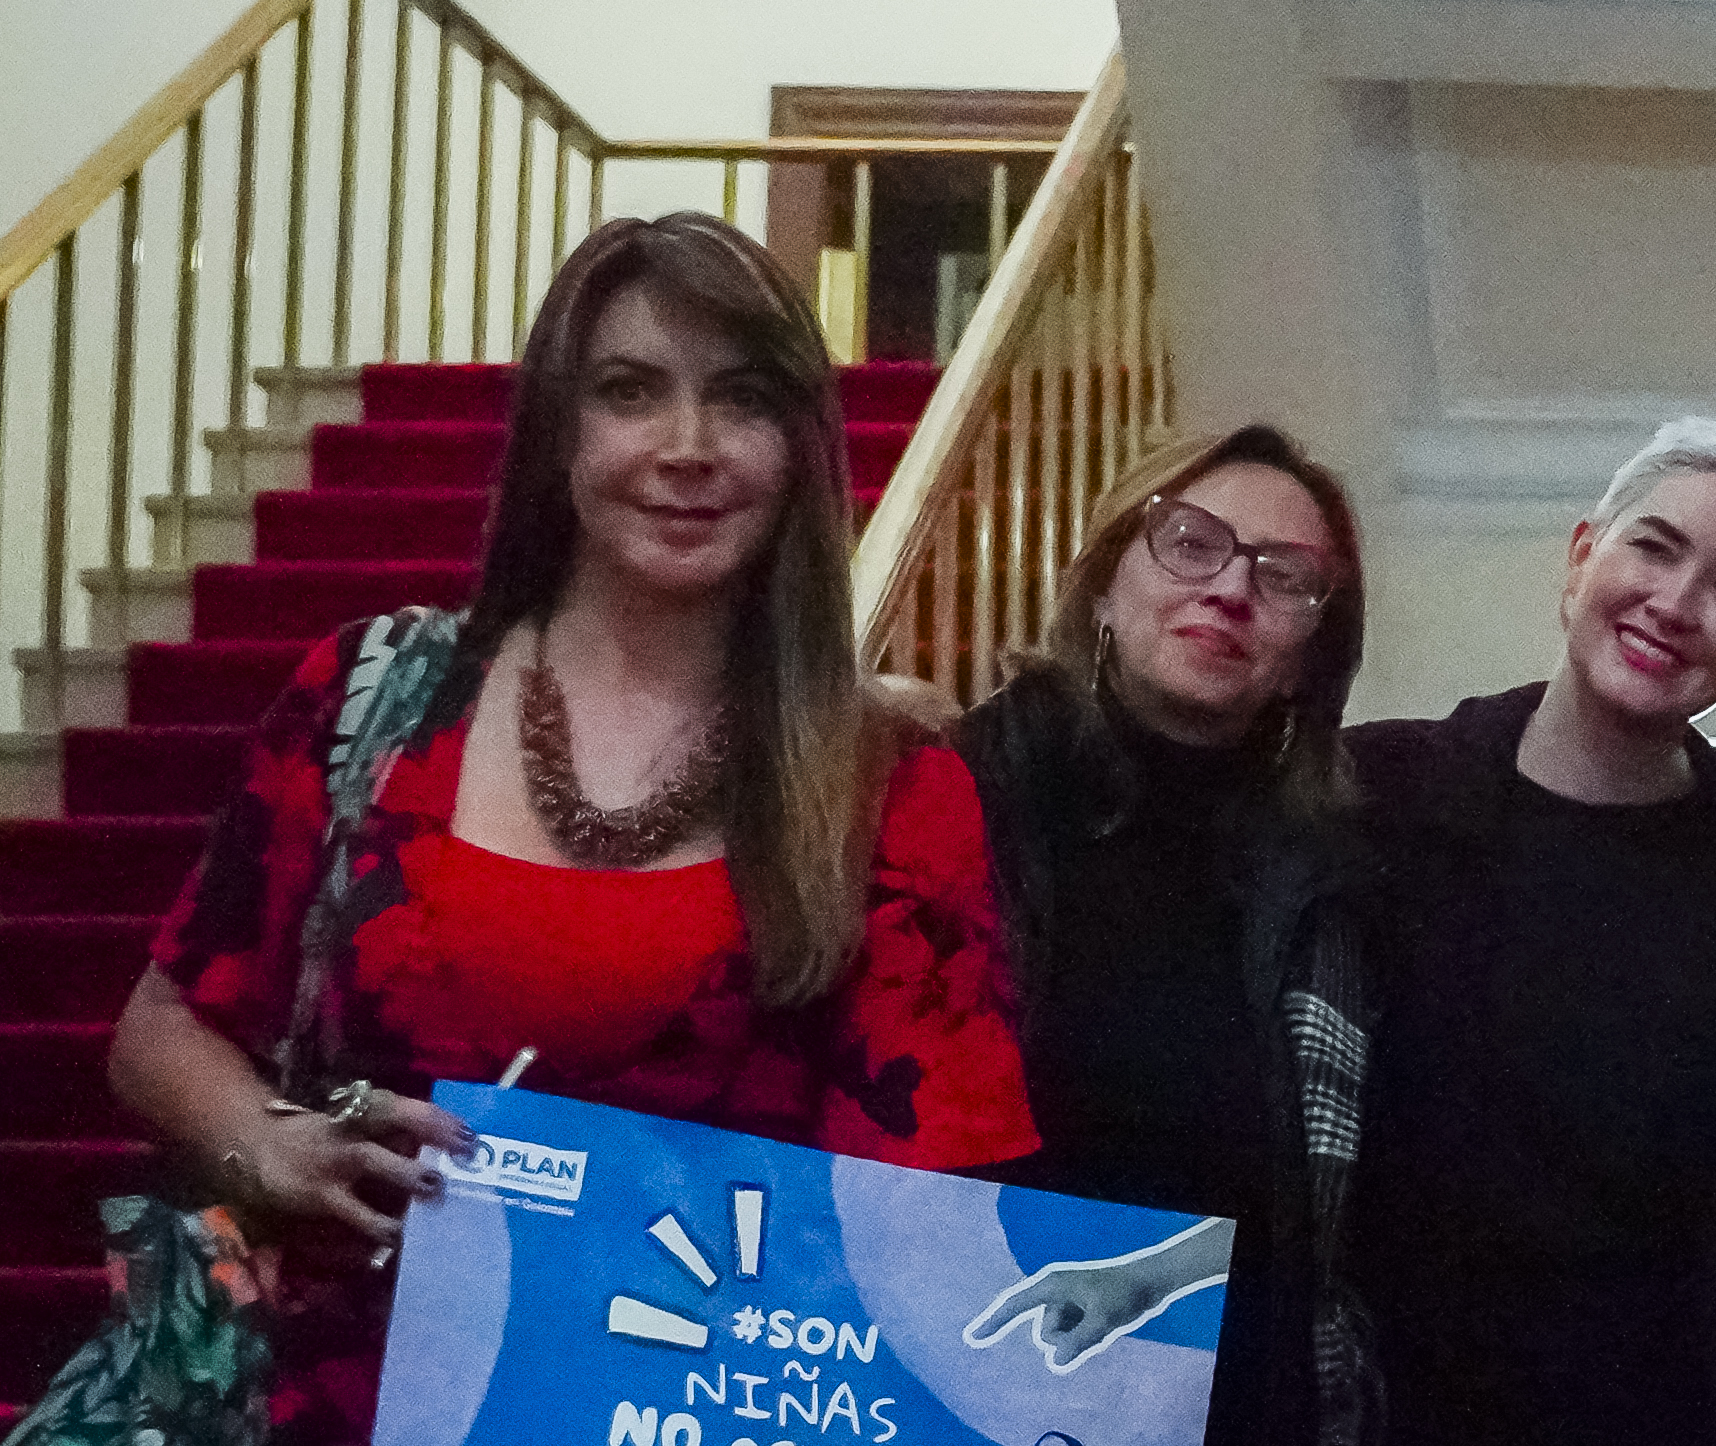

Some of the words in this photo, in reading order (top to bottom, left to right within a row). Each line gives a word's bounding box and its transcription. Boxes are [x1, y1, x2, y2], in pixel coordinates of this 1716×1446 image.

[501, 1150, 577, 1181] PLAN
[733, 1304, 879, 1363] #SON
[686, 1359, 898, 1443] NIÑAS
